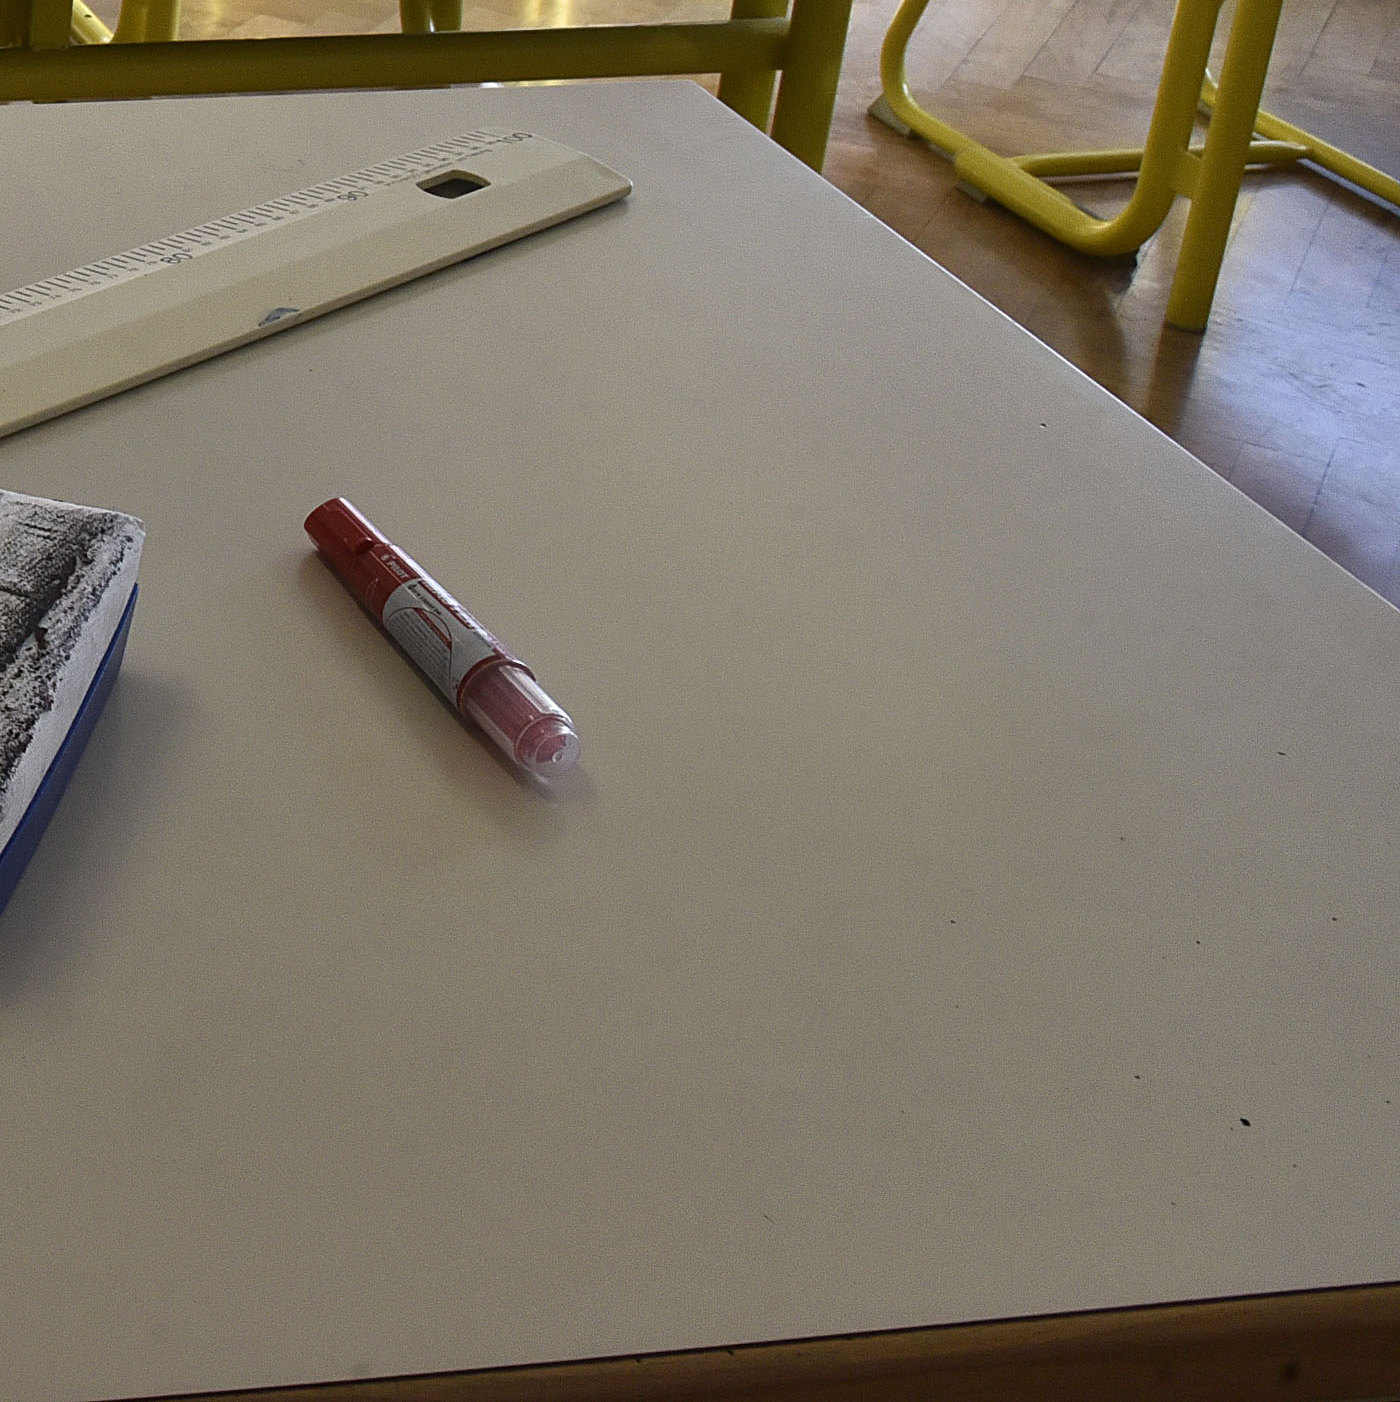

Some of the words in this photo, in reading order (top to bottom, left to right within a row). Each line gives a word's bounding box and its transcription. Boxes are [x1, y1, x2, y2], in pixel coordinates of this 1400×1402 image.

[160, 252, 193, 264] 80
[337, 190, 369, 202] 90
[386, 559, 410, 580] PILOT
